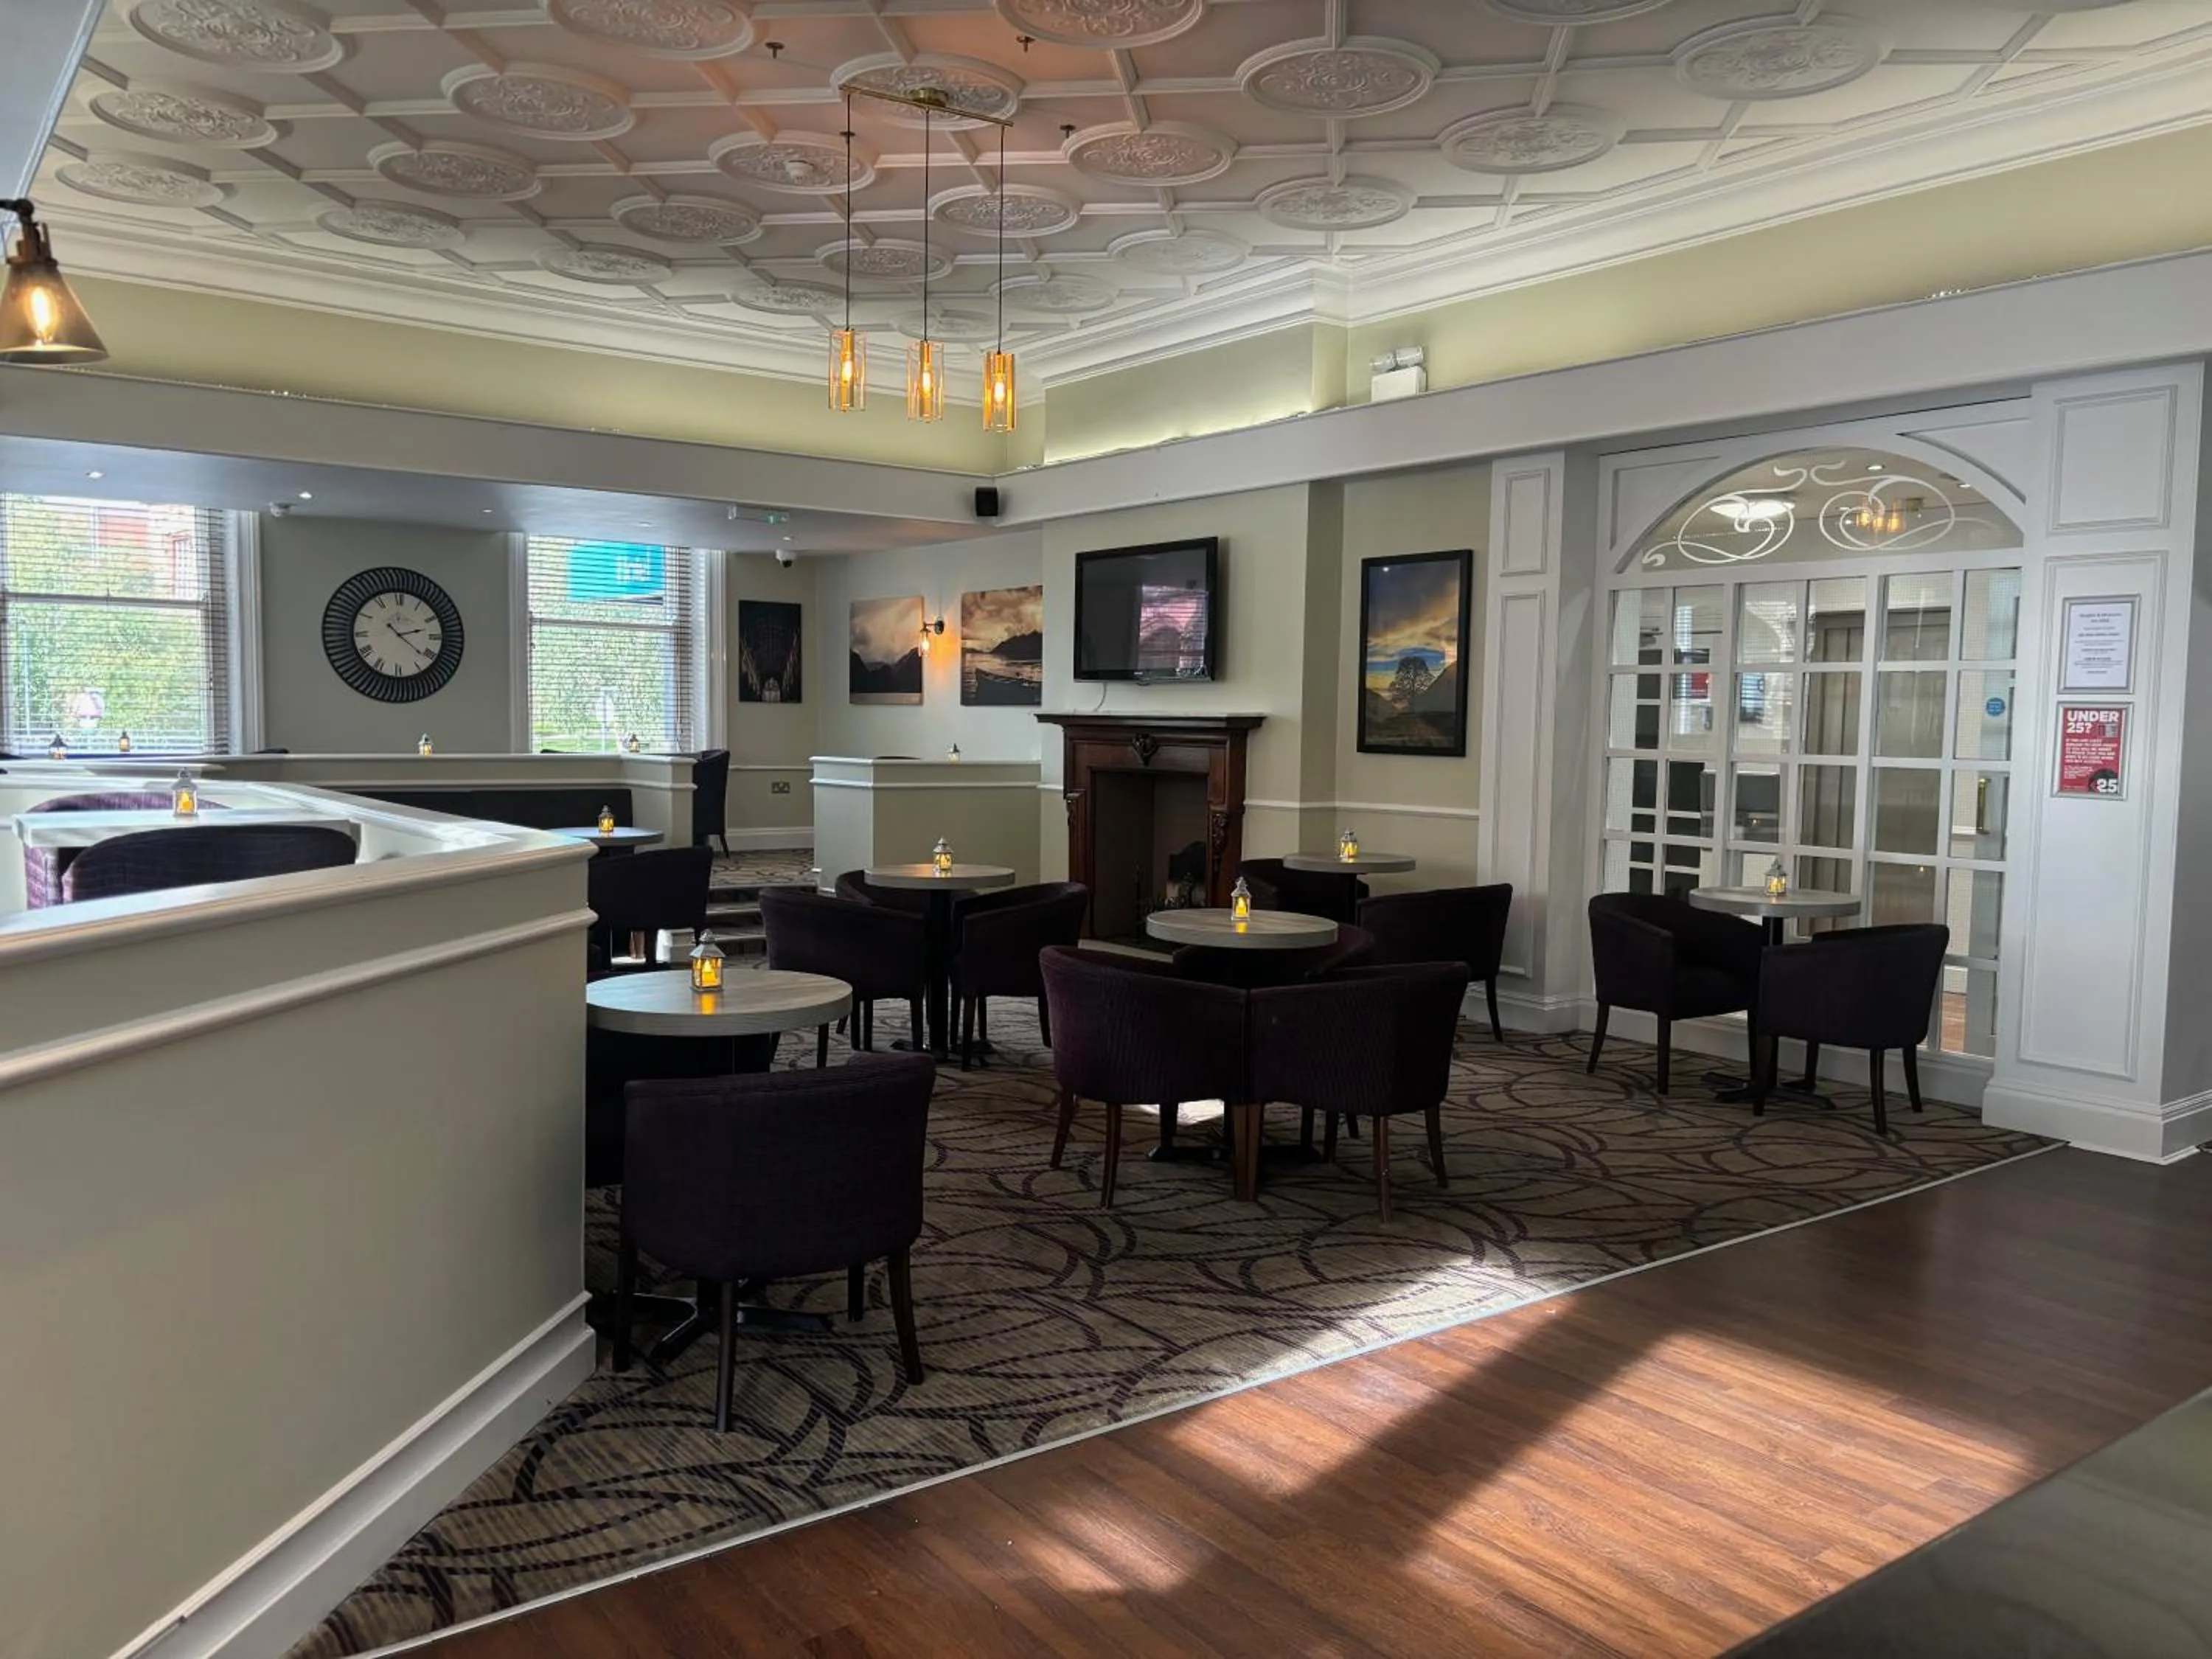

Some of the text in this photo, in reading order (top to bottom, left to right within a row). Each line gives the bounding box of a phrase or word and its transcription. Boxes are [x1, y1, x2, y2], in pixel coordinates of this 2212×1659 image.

[2067, 710, 2120, 723] UNDER
[2066, 723, 2093, 734] 25?
[2096, 778, 2118, 793] 25
